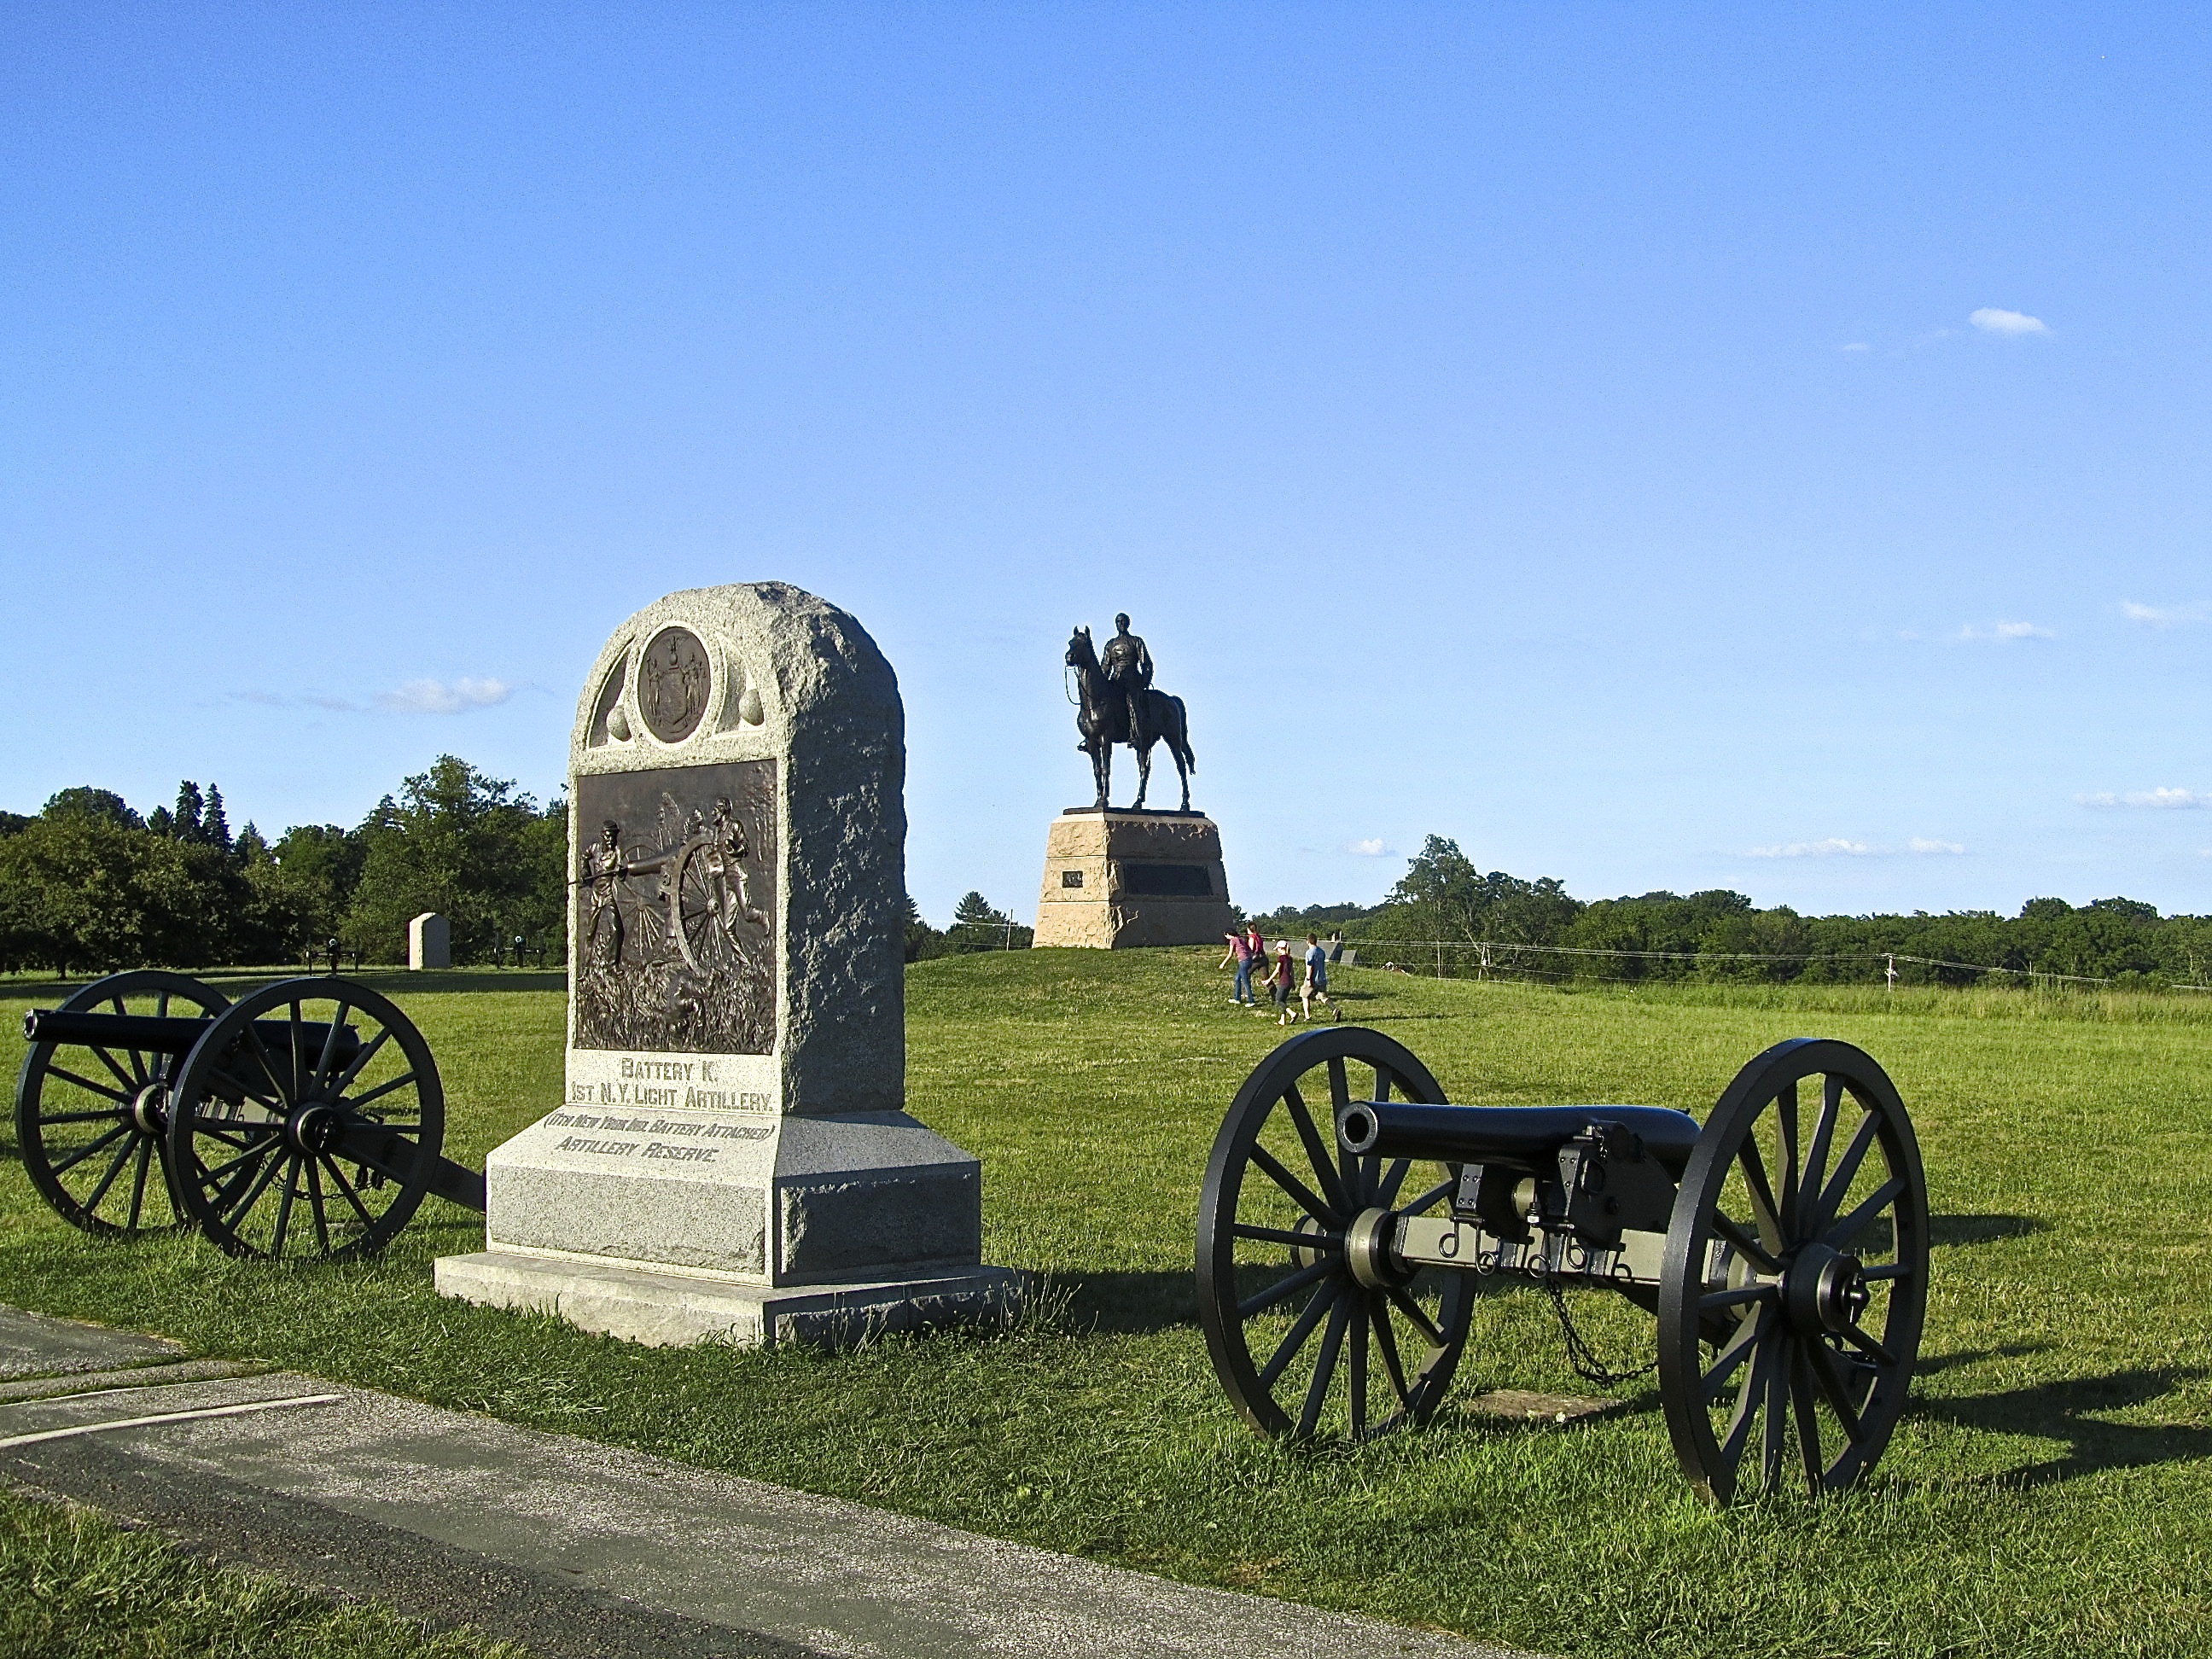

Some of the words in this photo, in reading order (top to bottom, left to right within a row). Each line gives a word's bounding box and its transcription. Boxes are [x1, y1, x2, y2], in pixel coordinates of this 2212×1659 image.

[622, 1057, 694, 1081] BATTERY
[572, 1081, 595, 1101] 1ST
[635, 1084, 677, 1106] LIGHT
[685, 1086, 773, 1112] ARTILLERY.
[571, 1114, 602, 1128] NEW
[599, 1115, 629, 1131] YORK
[649, 1119, 706, 1136] BATTERY
[554, 1136, 640, 1156] ARTILLERY
